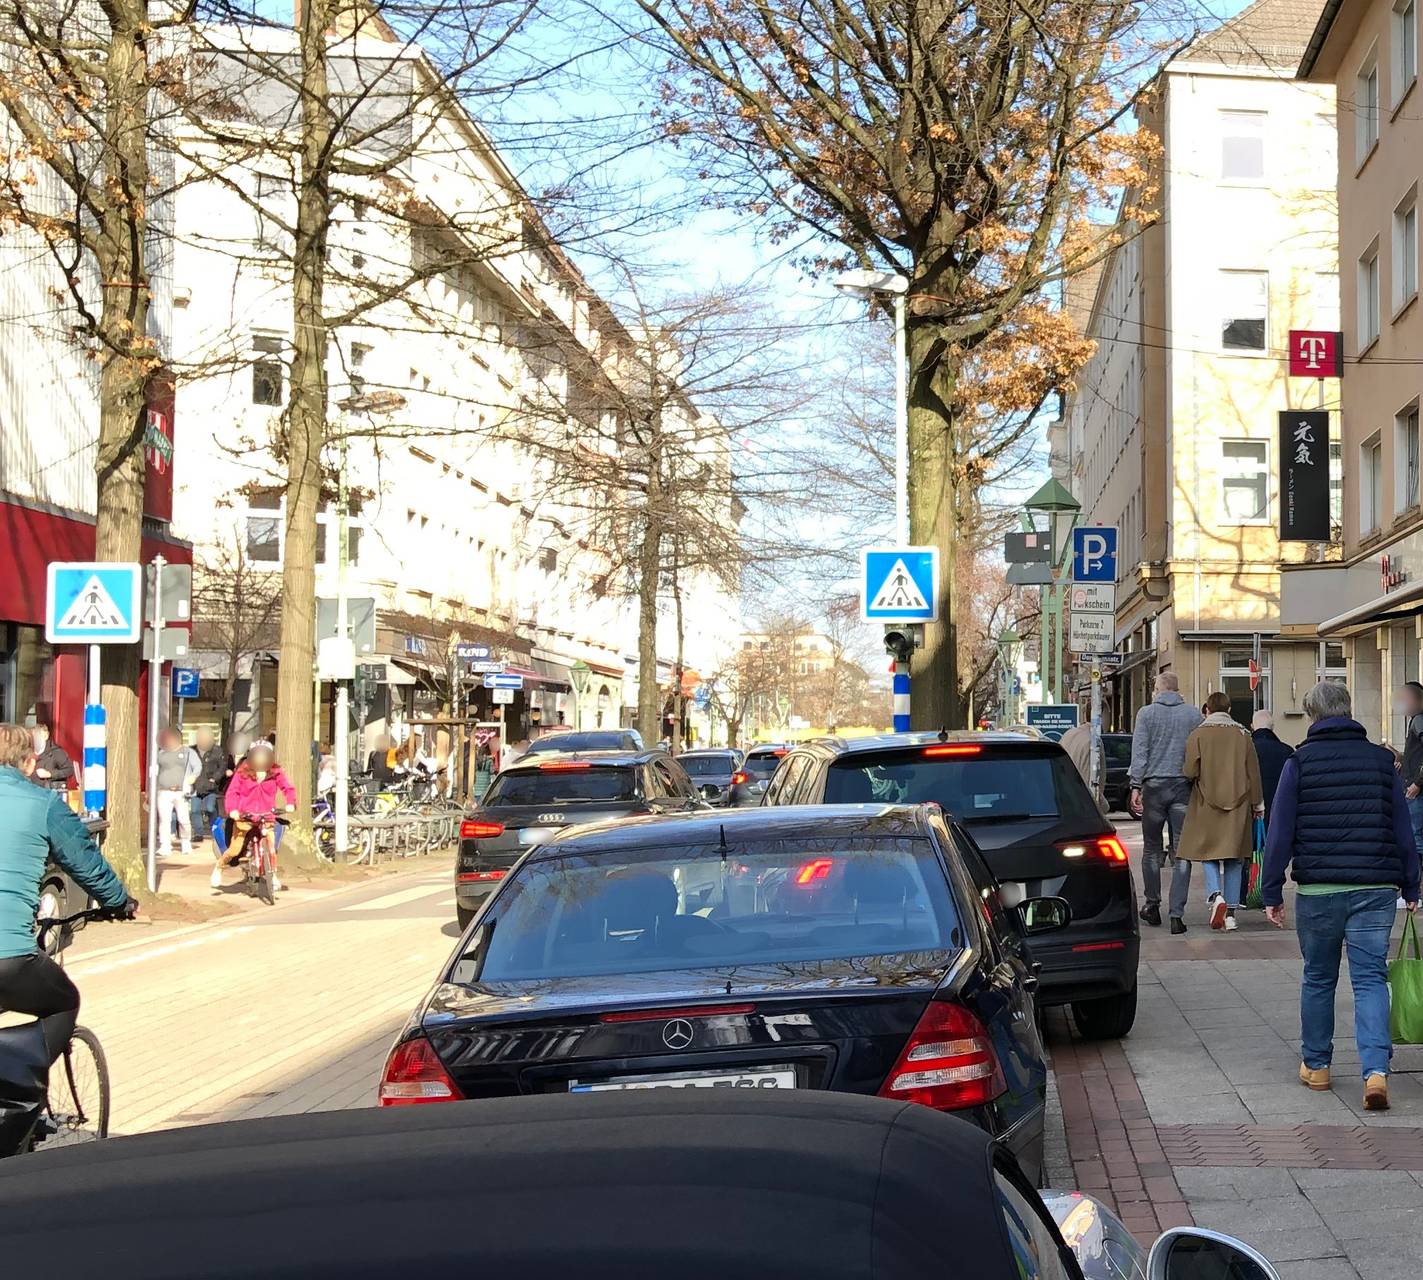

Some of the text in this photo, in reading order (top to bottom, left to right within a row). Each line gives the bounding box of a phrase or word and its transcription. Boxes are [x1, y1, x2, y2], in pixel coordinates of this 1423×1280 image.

[1300, 337, 1327, 368] T
[1293, 420, 1315, 466] 元気
[1083, 534, 1107, 575] P
[1087, 588, 1098, 596] mit
[1074, 600, 1110, 608] rkschein
[458, 647, 488, 657] KIND
[177, 671, 194, 693] P
